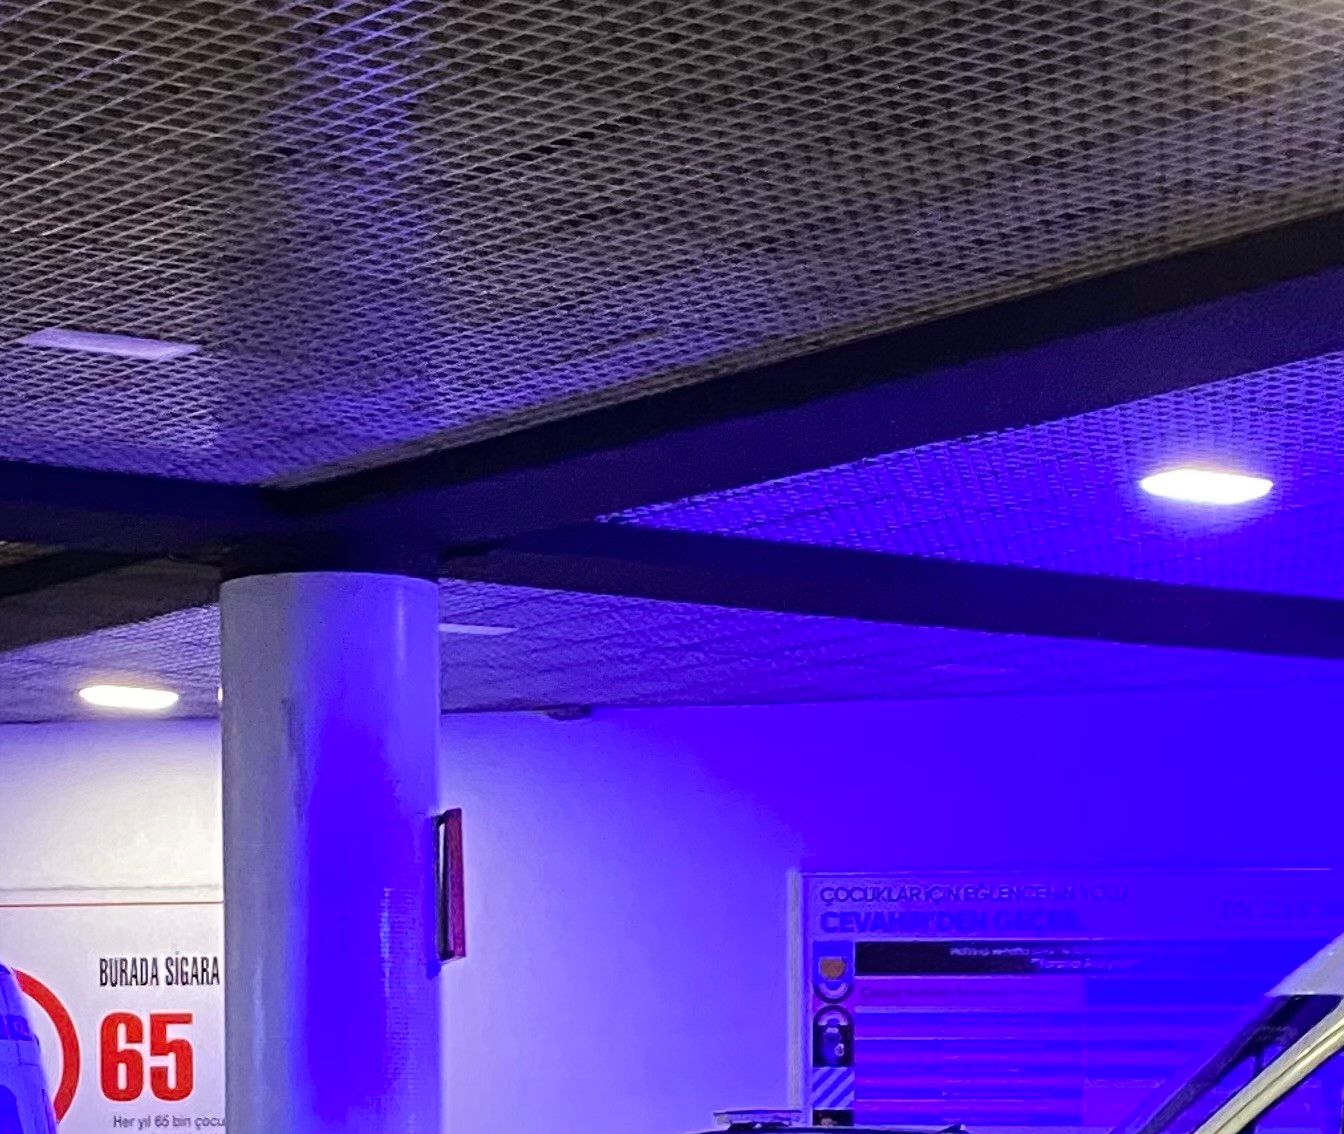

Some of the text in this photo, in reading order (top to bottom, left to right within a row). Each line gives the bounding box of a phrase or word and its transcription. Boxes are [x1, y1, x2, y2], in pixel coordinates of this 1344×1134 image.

[100, 951, 220, 987] BURADA SİGARA
[101, 1012, 193, 1102] 65
[113, 1115, 134, 1128] Her
[173, 1115, 191, 1128] bin
